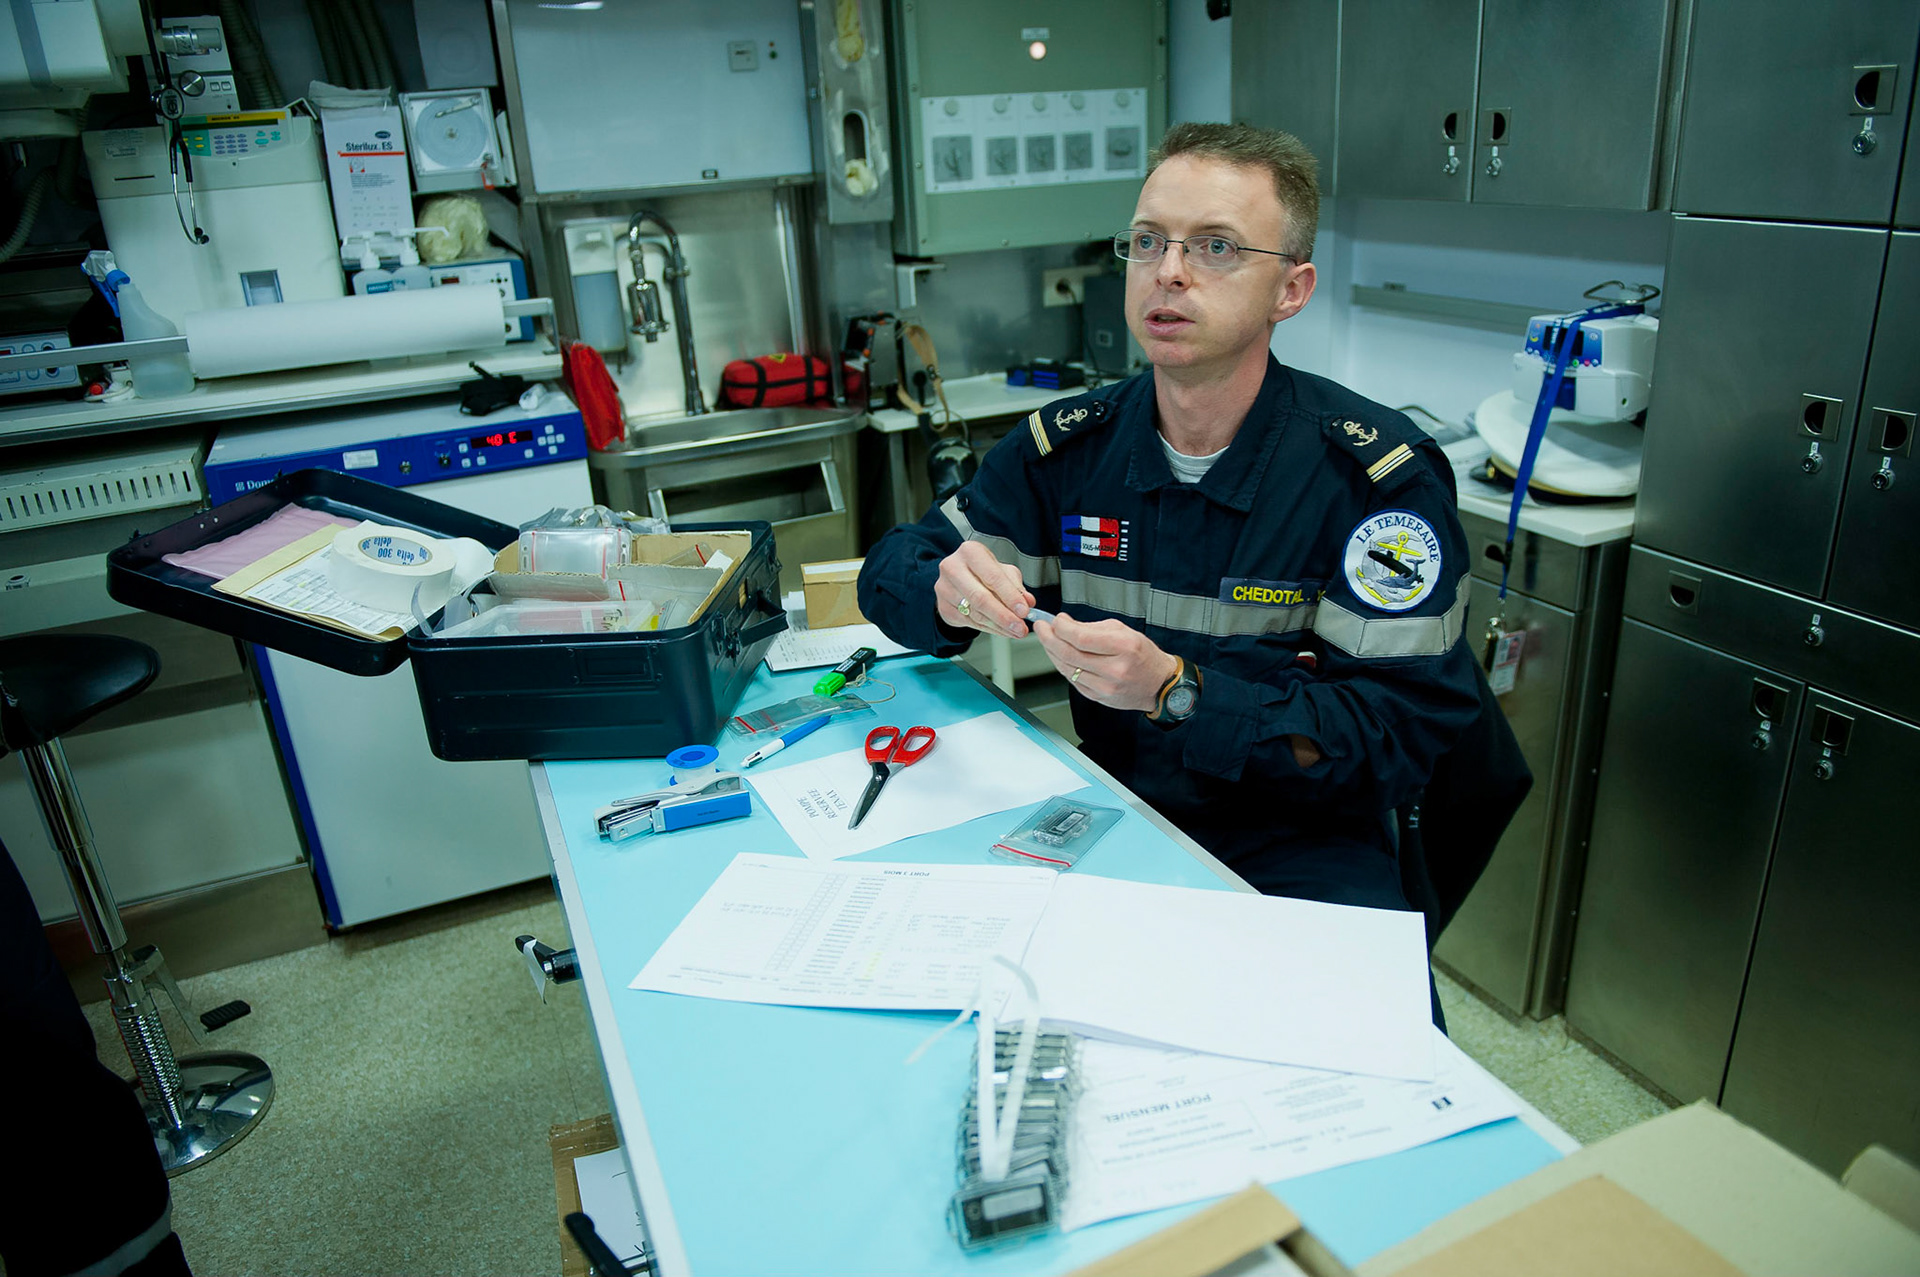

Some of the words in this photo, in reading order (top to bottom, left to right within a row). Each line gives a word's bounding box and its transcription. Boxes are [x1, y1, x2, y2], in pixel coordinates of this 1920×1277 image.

[381, 141, 393, 151] ES
[373, 537, 392, 547] delta
[1356, 525, 1375, 544] LE
[1374, 515, 1440, 563] TEMERAIRE
[377, 547, 394, 558] 300
[396, 549, 415, 563] delta
[1232, 585, 1304, 605] CHEDOTAL
[1175, 1093, 1212, 1109] PORT
[1105, 1103, 1170, 1123] MENSUEL
